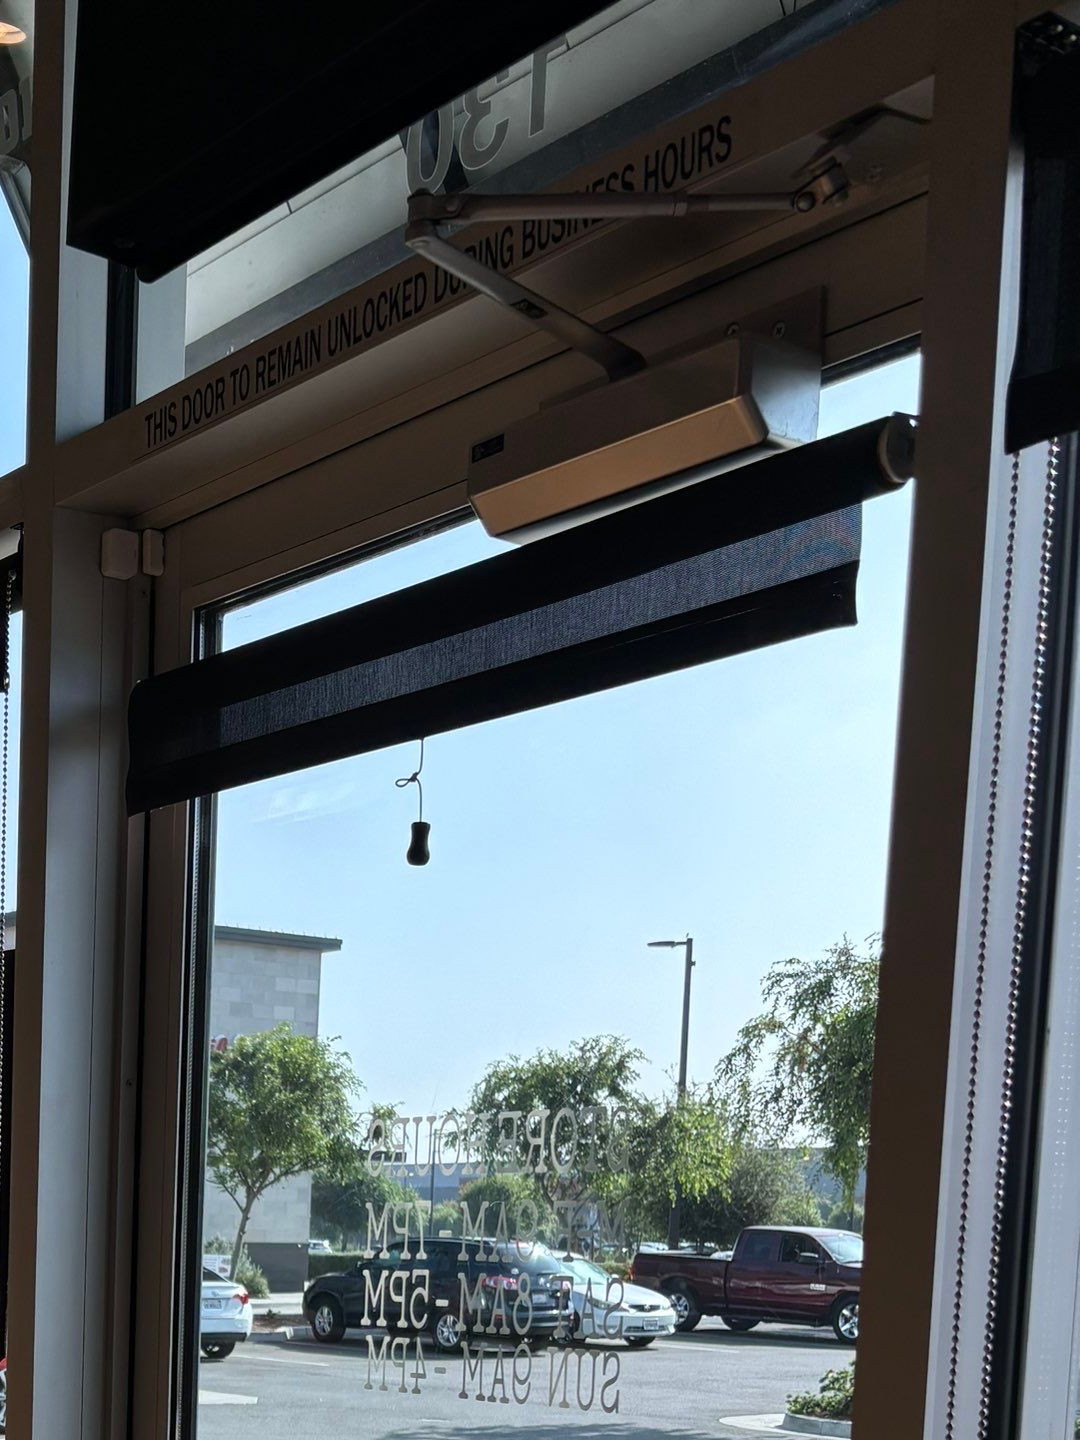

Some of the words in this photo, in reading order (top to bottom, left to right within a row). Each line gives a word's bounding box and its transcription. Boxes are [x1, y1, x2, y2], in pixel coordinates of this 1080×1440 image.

[145, 402, 177, 448] THIS
[182, 371, 225, 431] DOOR
[230, 364, 250, 406] TO
[255, 325, 321, 394] REMAIN
[328, 271, 427, 357] UNLOCKED
[644, 115, 732, 193] HOURS
